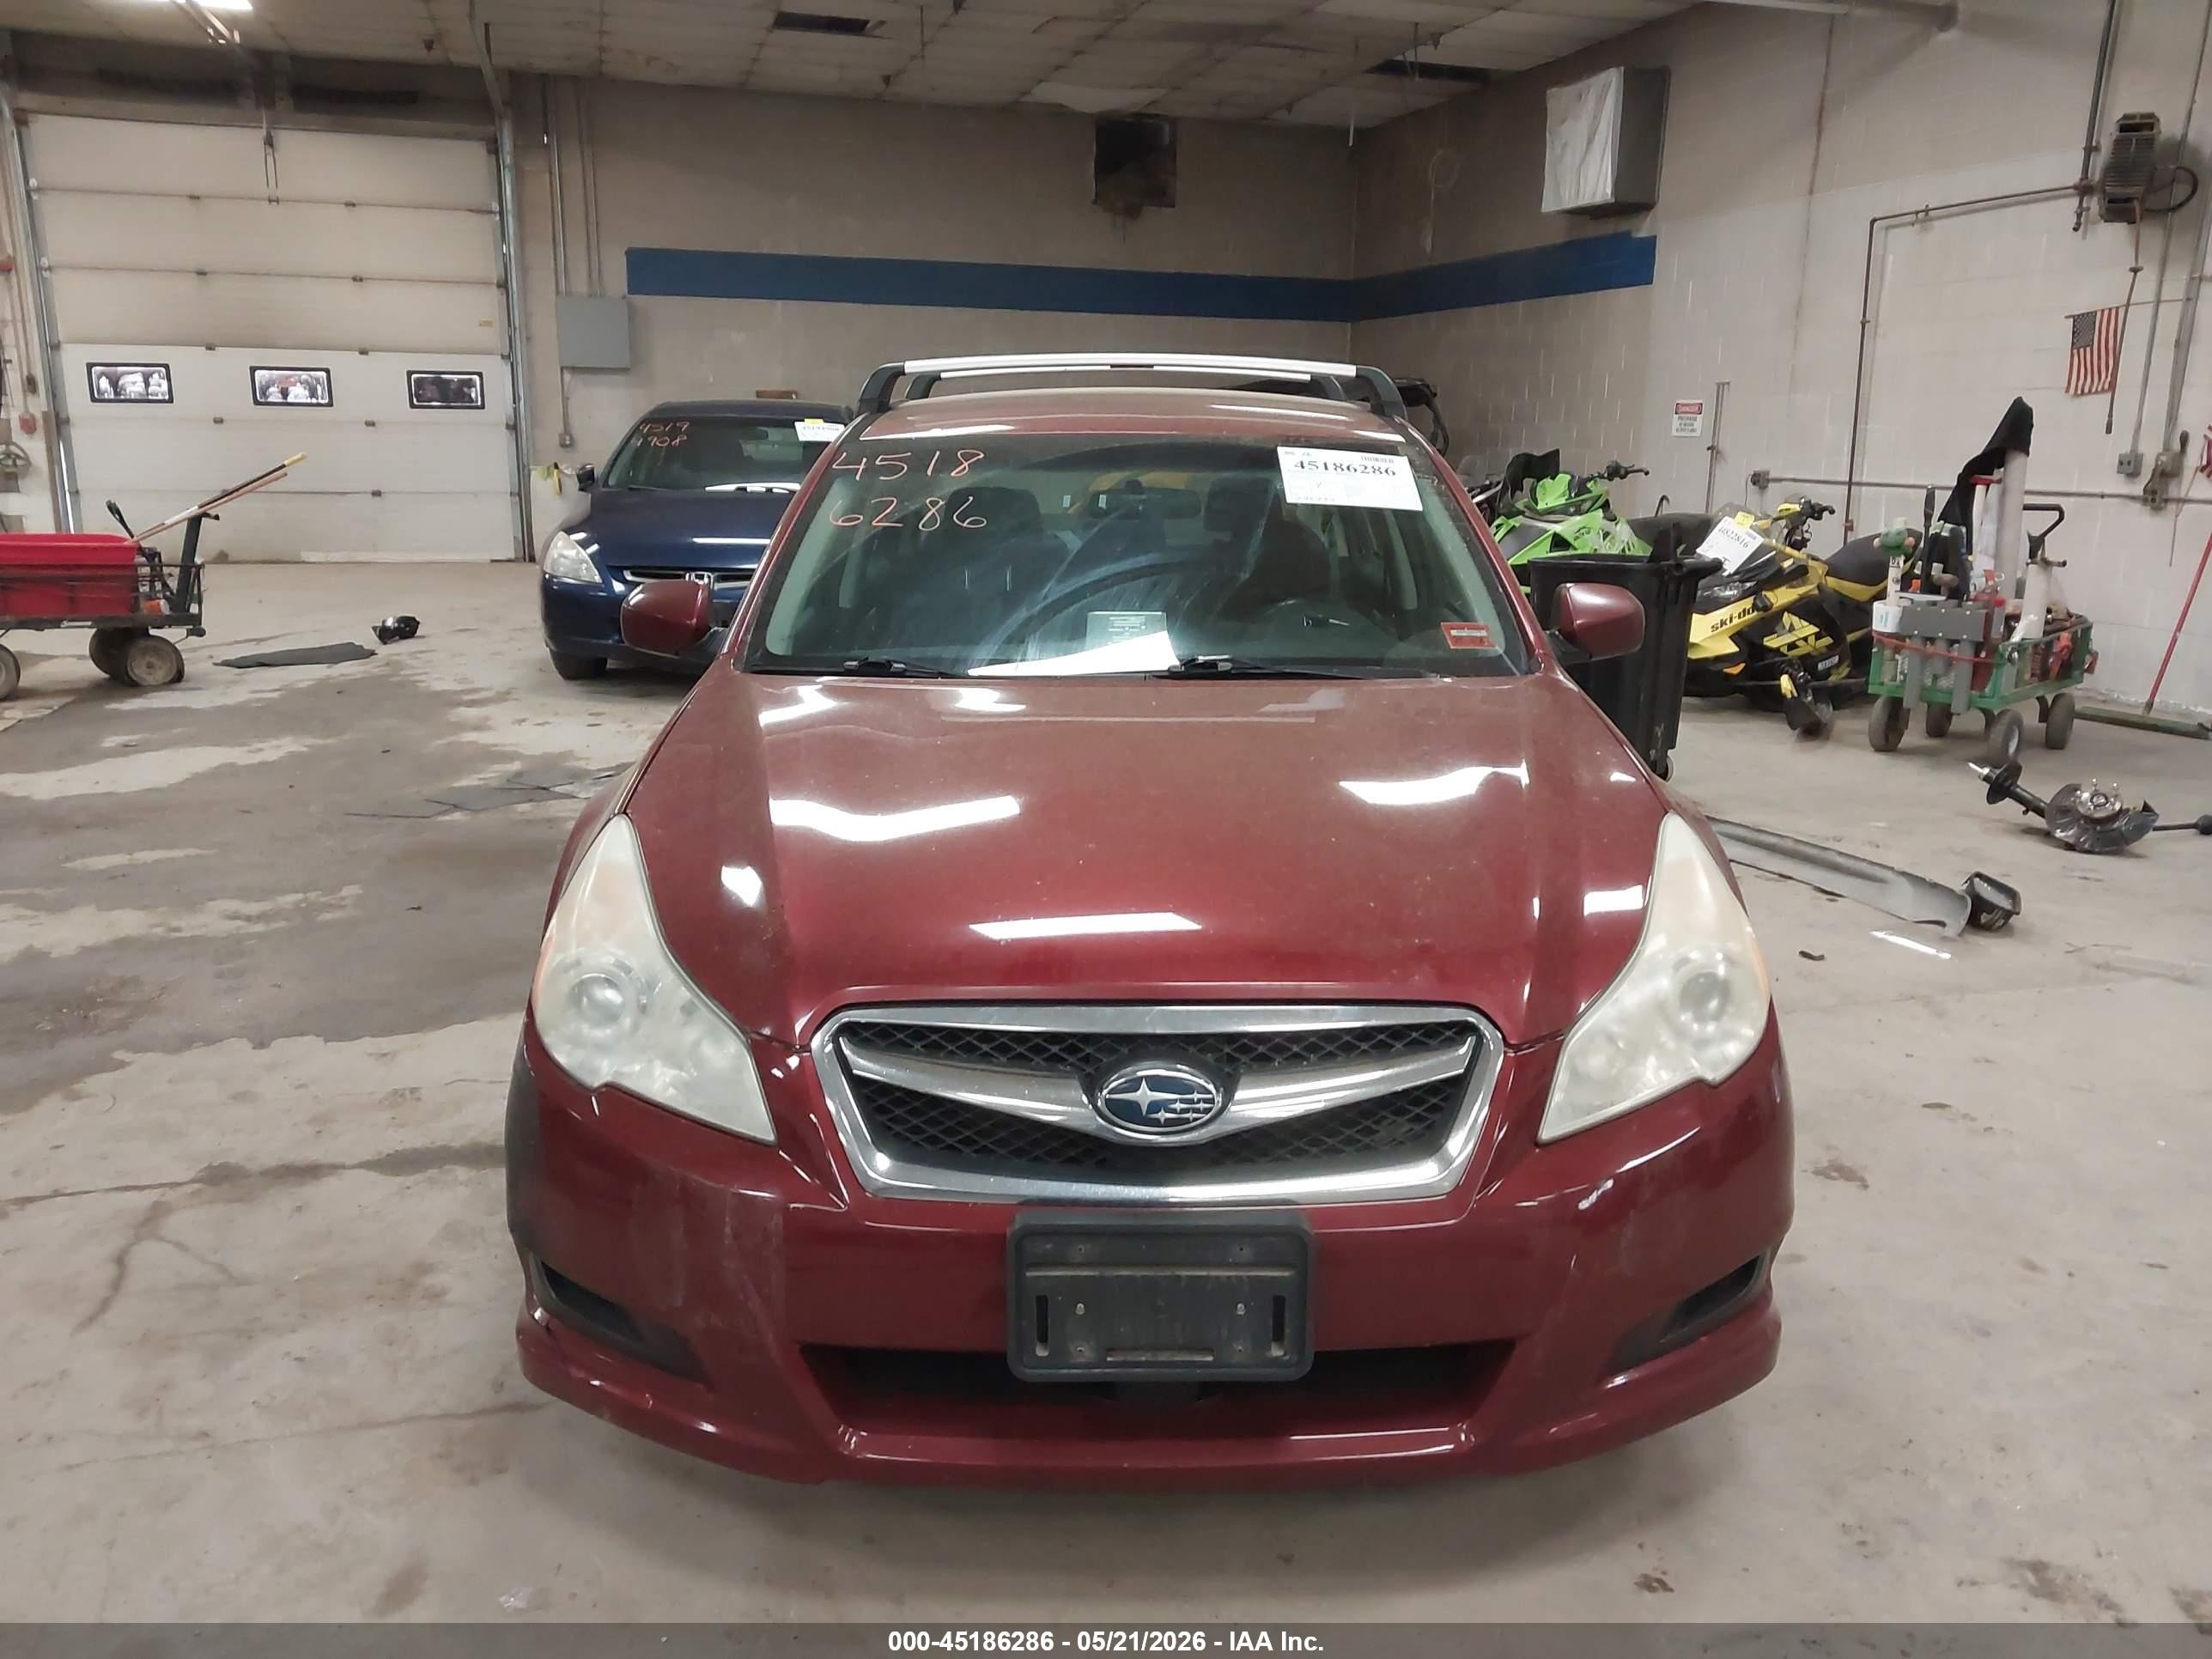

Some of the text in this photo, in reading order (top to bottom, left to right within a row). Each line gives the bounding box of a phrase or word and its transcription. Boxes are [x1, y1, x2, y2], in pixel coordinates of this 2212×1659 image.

[831, 449, 985, 482] 4518
[1294, 459, 1396, 477] 45186286
[829, 495, 988, 532] 6286
[1711, 605, 1757, 633] ski-do
